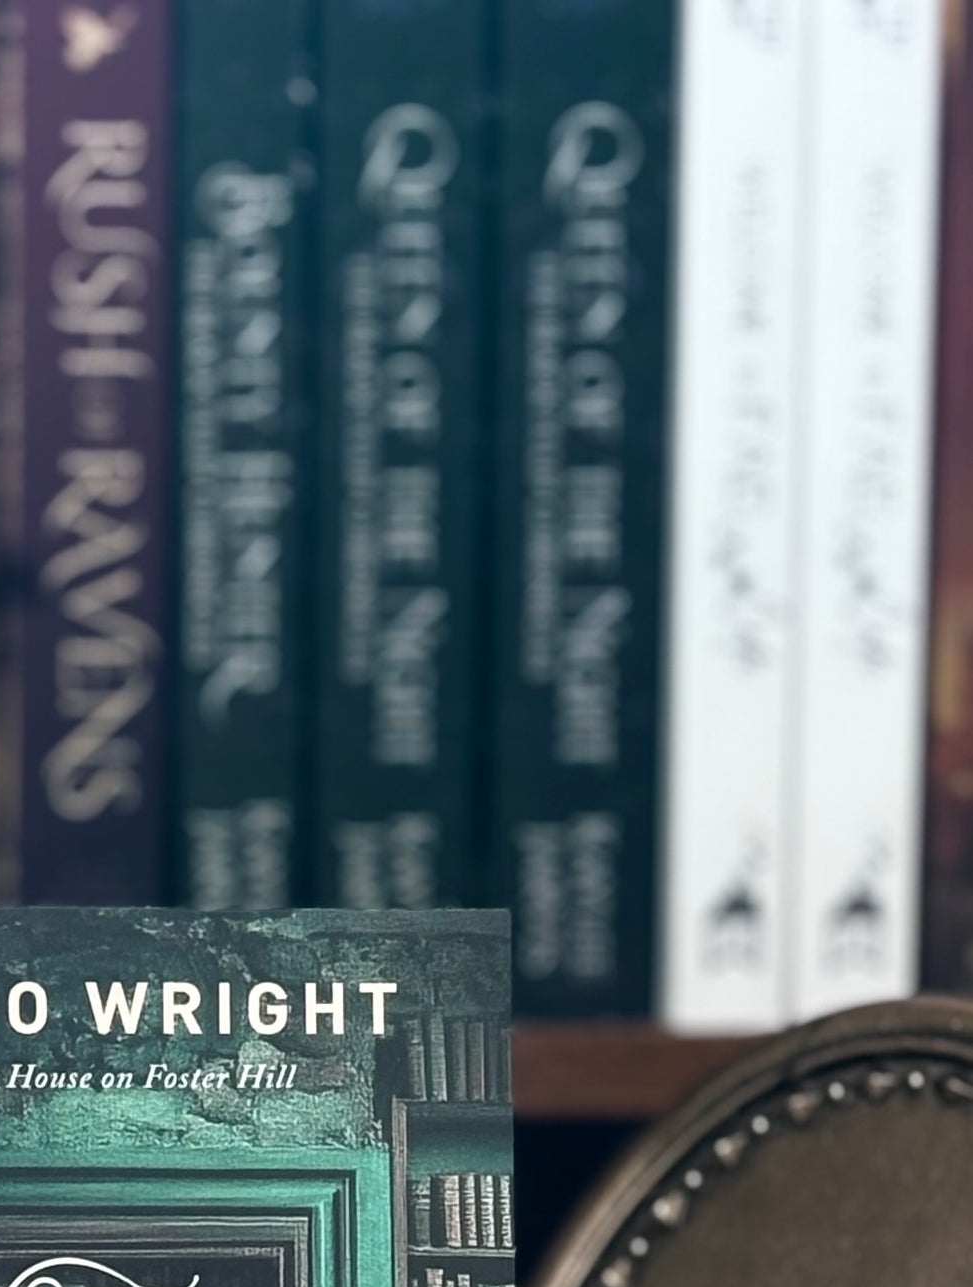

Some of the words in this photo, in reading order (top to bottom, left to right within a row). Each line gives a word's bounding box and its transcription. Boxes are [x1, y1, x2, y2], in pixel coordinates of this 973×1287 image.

[45, 118, 160, 380] RUSH
[84, 980, 398, 1036] WRIGHT
[5, 1063, 93, 1090] House
[100, 1071, 134, 1090] on
[142, 1062, 231, 1091] Foster
[236, 1062, 298, 1090] Hill
